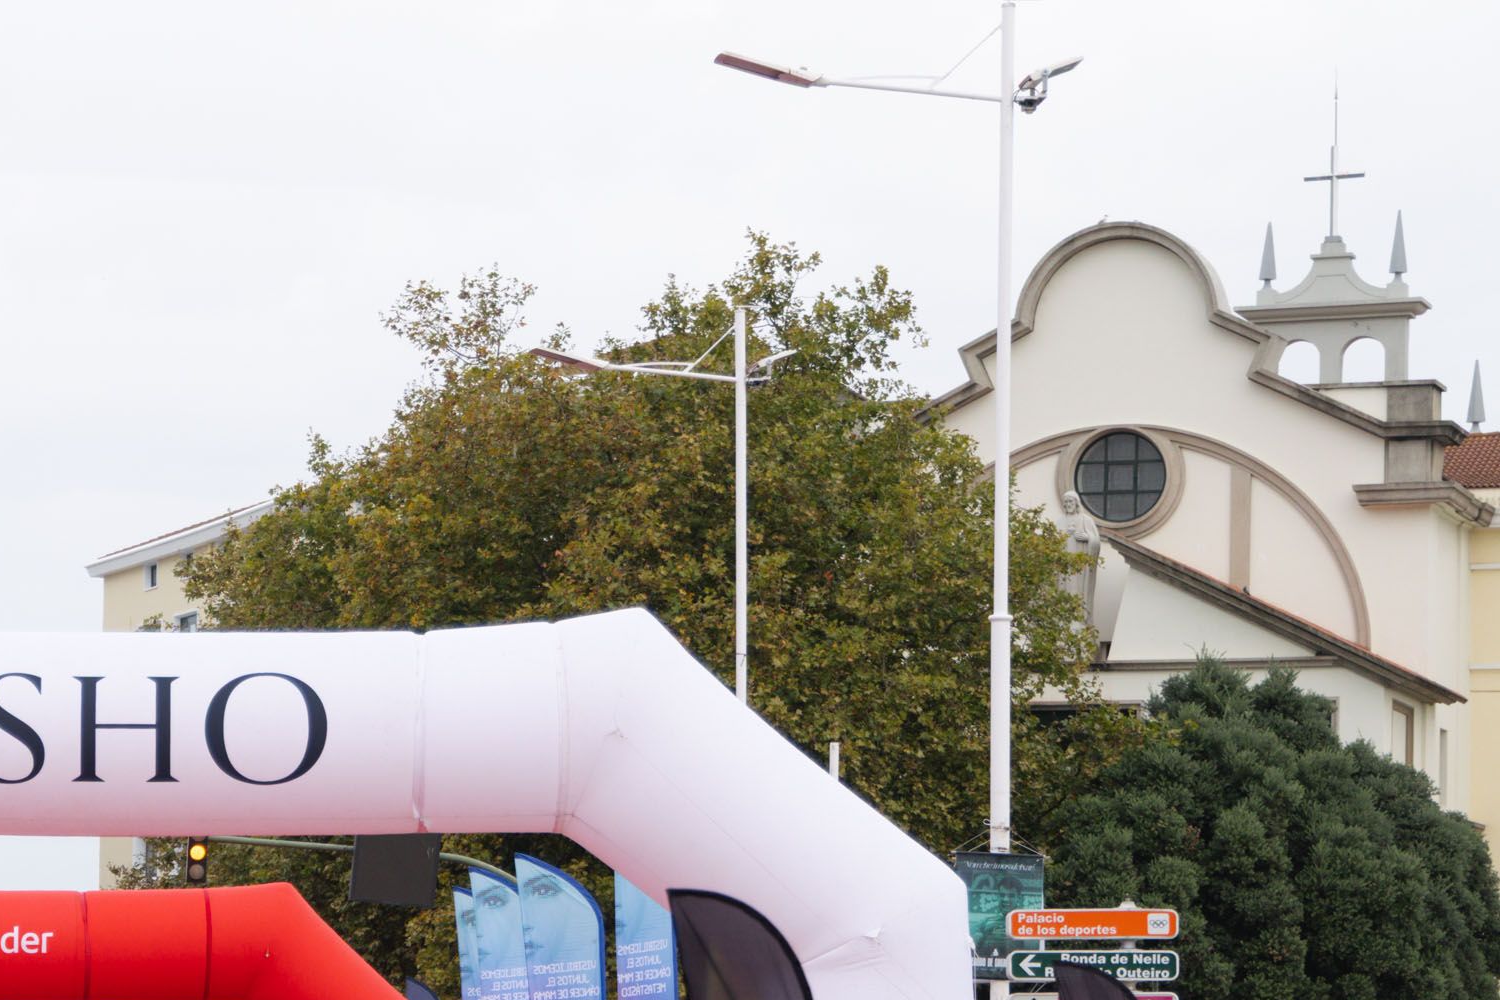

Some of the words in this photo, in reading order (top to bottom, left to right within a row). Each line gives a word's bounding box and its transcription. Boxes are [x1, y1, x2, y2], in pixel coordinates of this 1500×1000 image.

[1018, 912, 1065, 924] Palacio
[1018, 925, 1033, 935] de
[1037, 924, 1055, 935] los
[1058, 924, 1117, 937] deportes
[1061, 953, 1107, 966] Ronda
[1111, 953, 1128, 965] de
[1132, 953, 1170, 965] Nelle
[1116, 966, 1170, 979] Outeiro
